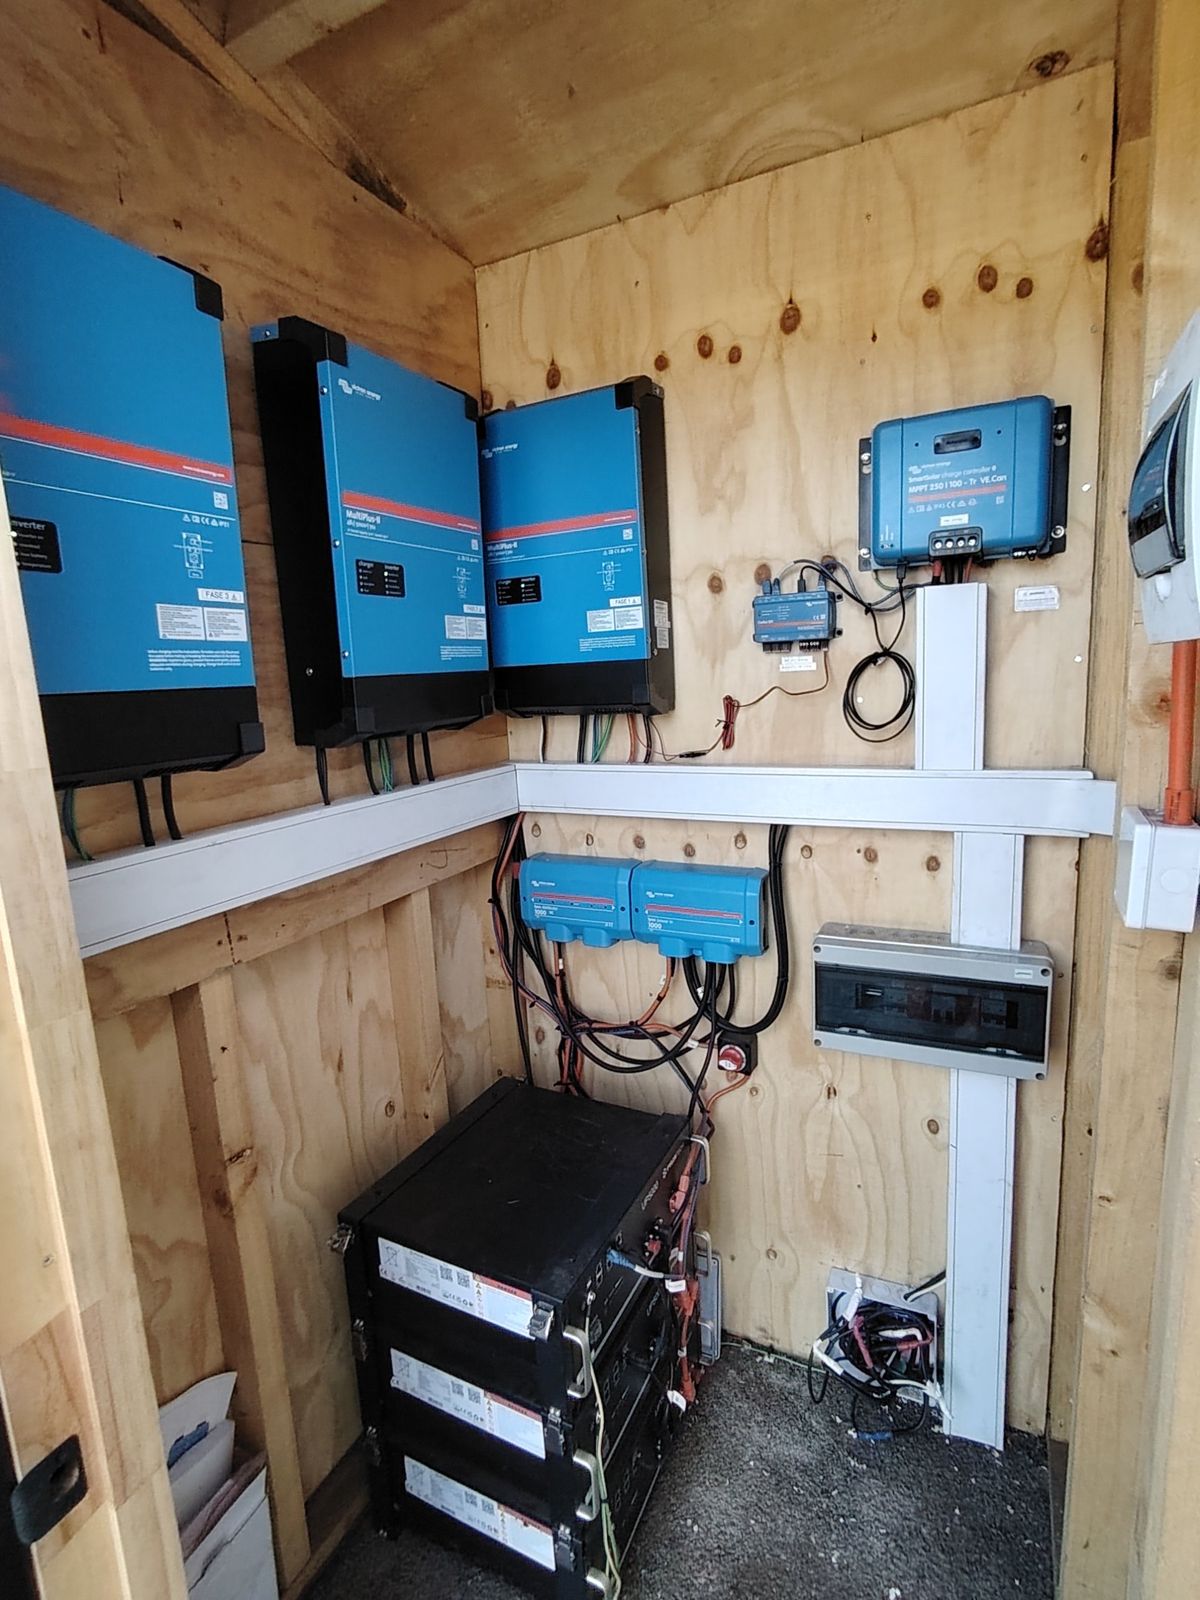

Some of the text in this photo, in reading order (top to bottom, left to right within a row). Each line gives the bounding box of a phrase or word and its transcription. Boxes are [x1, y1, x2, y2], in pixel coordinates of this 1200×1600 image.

[908, 484, 929, 493] MPPT
[929, 481, 945, 490] 250
[948, 480, 963, 488] 100
[979, 474, 1008, 484] VE.Can
[11, 520, 46, 530] nverter
[205, 590, 224, 599] FASE
[648, 922, 663, 930] 1000
